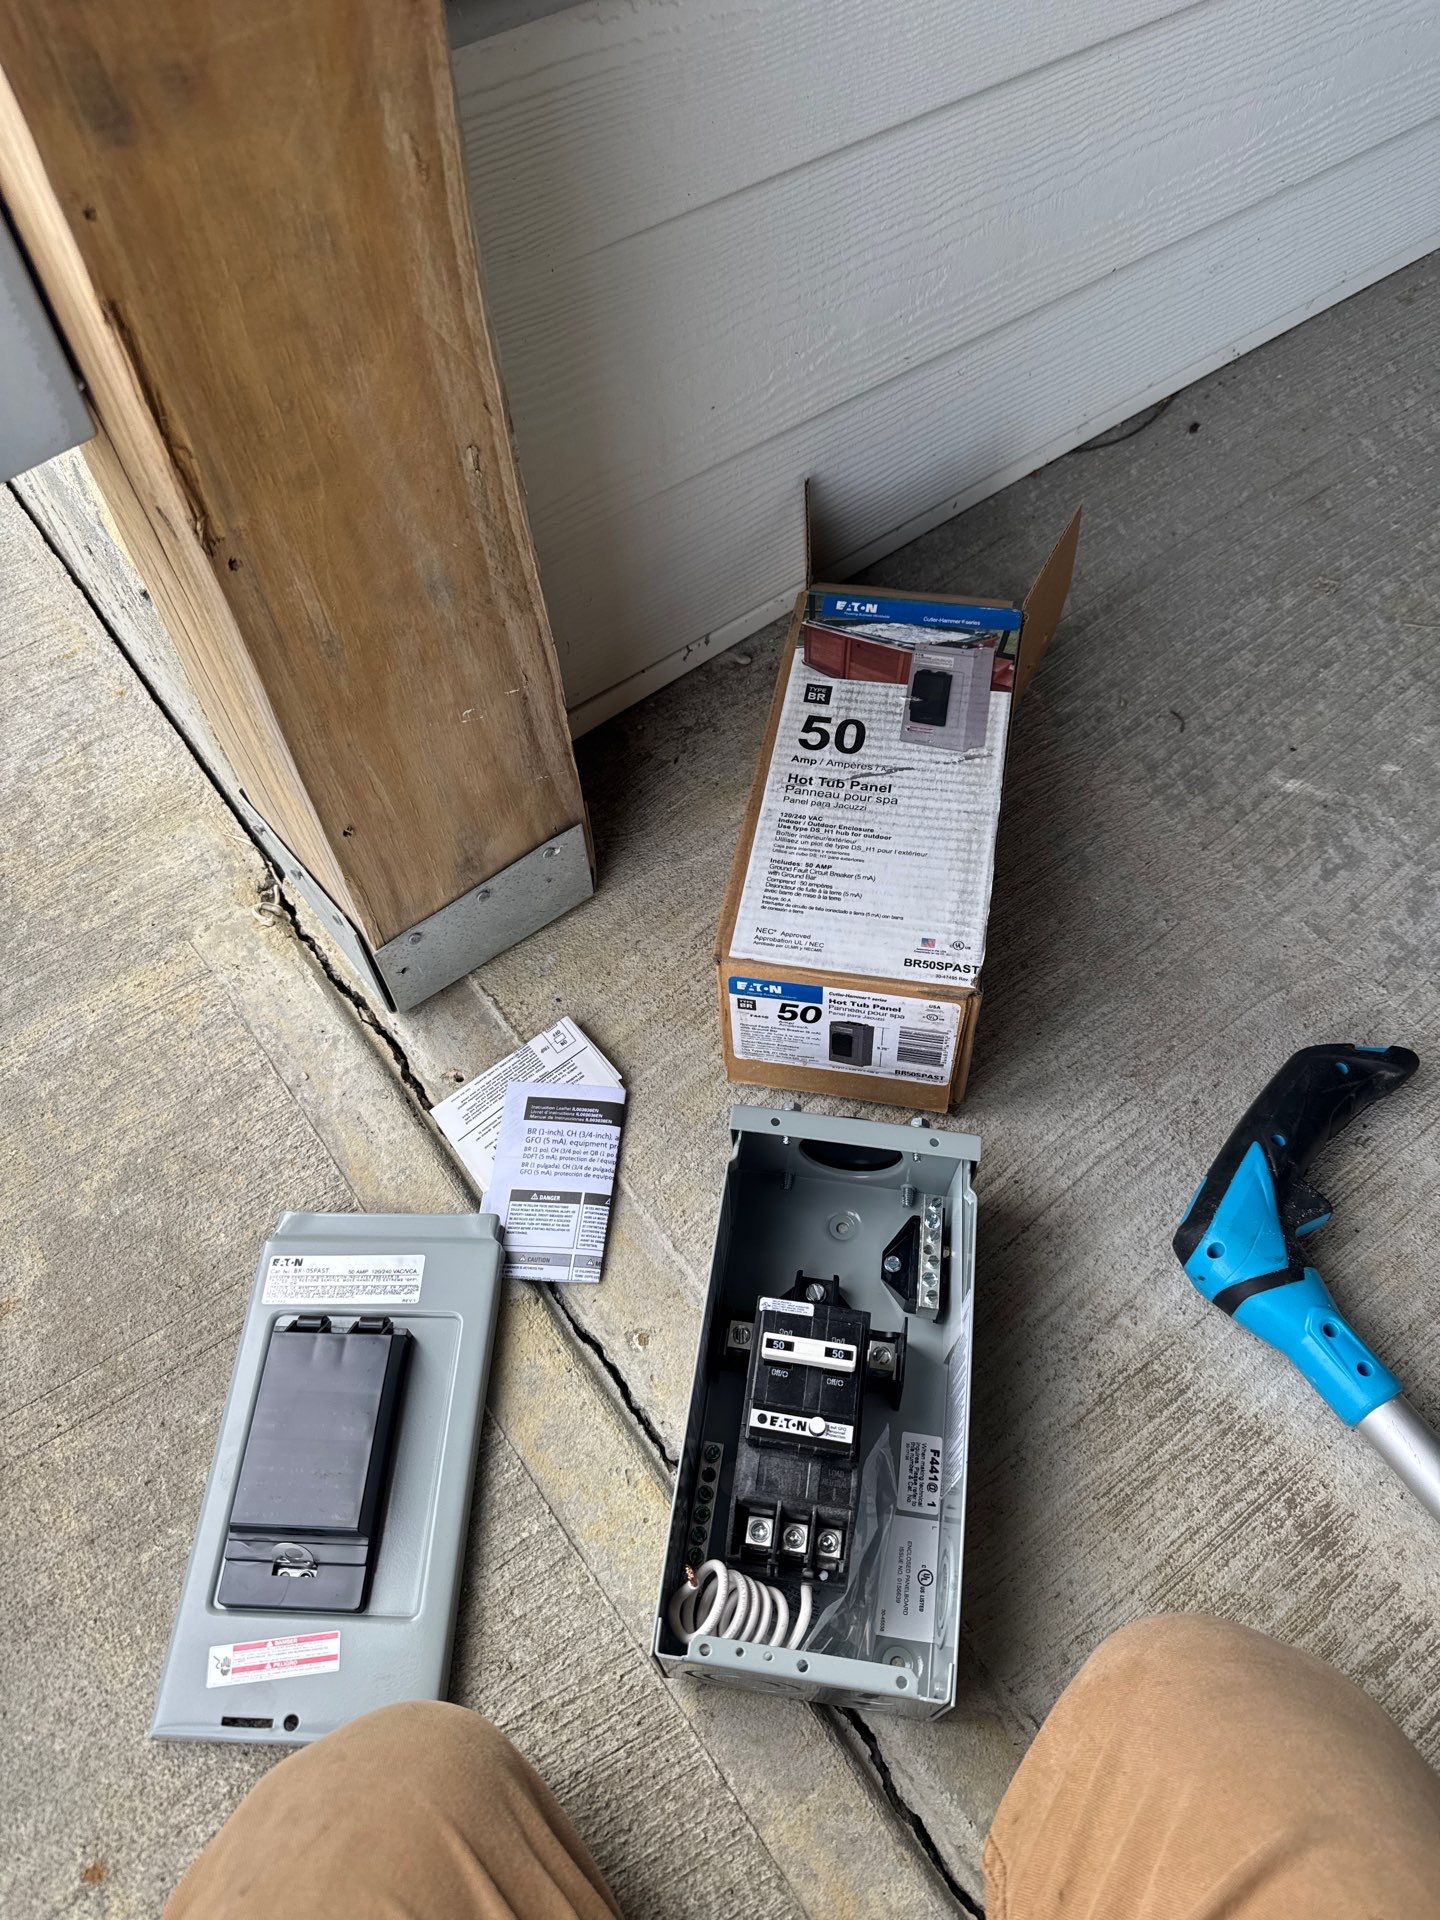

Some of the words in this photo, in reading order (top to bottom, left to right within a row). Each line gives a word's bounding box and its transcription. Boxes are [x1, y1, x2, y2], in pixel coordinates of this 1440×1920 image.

[836, 600, 878, 613] EATON
[809, 686, 828, 694] TYPE
[807, 692, 828, 702] BR
[798, 715, 866, 754] 50
[791, 755, 817, 766] Amp
[826, 760, 872, 771] Ampères
[788, 773, 814, 786] Hot
[819, 776, 845, 788] Tub
[850, 780, 892, 793] Panel
[785, 785, 840, 799] Panneau
[844, 794, 872, 802] pour
[876, 796, 898, 806] spa
[783, 795, 808, 805] Panel
[810, 800, 831, 808] para
[833, 802, 867, 811] Jacuzzi
[780, 812, 806, 820] 120/240
[793, 825, 808, 833] type
[808, 821, 837, 829] Outdoor
[838, 824, 874, 833] Enclosure
[774, 836, 799, 844] Utilisez
[835, 843, 850, 851] type
[770, 858, 802, 867] Includes:
[769, 864, 792, 872] Ground
[809, 868, 828, 876] Circuit
[830, 871, 854, 879] Breaker
[781, 872, 805, 880] Ground
[766, 876, 796, 885] Comprend
[754, 935, 792, 944] Approbation
[781, 931, 811, 939] Approved
[904, 958, 980, 974] BR50SPAST
[736, 981, 782, 994] EATON
[777, 1003, 822, 1024] 50
[829, 1004, 866, 1014] Panneau
[873, 1003, 901, 1013] Panel
[895, 1069, 945, 1081] BR50SPAST
[570, 1139, 608, 1148] equipment
[773, 1340, 785, 1349] 50
[832, 1349, 844, 1359] 50
[770, 1416, 807, 1431] EATON
[927, 1449, 940, 1493] F441@
[903, 1575, 911, 1616] PANELBOARD
[274, 1638, 298, 1646] DANGER
